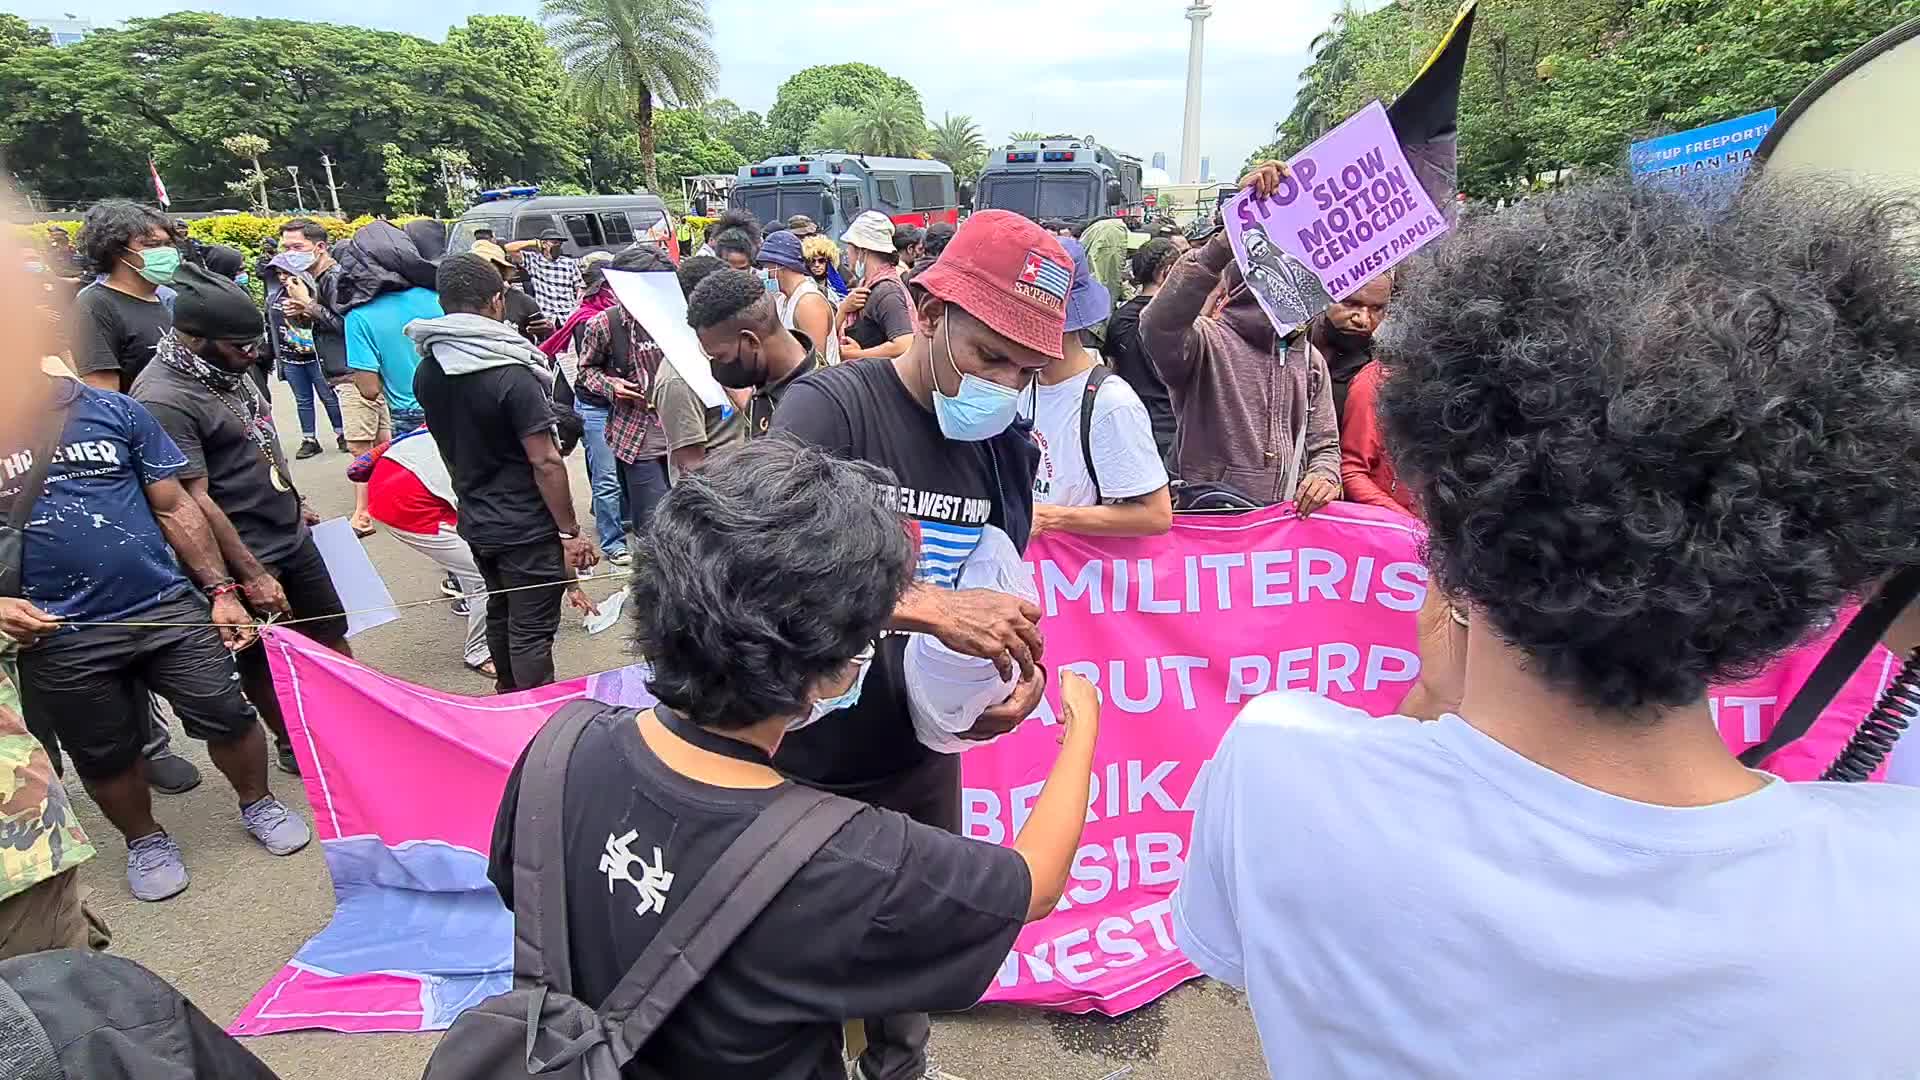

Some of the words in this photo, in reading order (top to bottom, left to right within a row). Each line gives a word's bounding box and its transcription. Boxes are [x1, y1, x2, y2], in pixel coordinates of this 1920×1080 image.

[1237, 158, 1317, 231] STOP
[1297, 165, 1407, 253] MOTION
[1313, 146, 1385, 211] SLOW
[1311, 189, 1418, 270] GENOCIDE
[1327, 274, 1350, 296] IN
[1349, 246, 1391, 281] WEST
[1390, 214, 1440, 255] PAPUA
[917, 490, 962, 520] WEST
[1057, 832, 1185, 911] SIB
